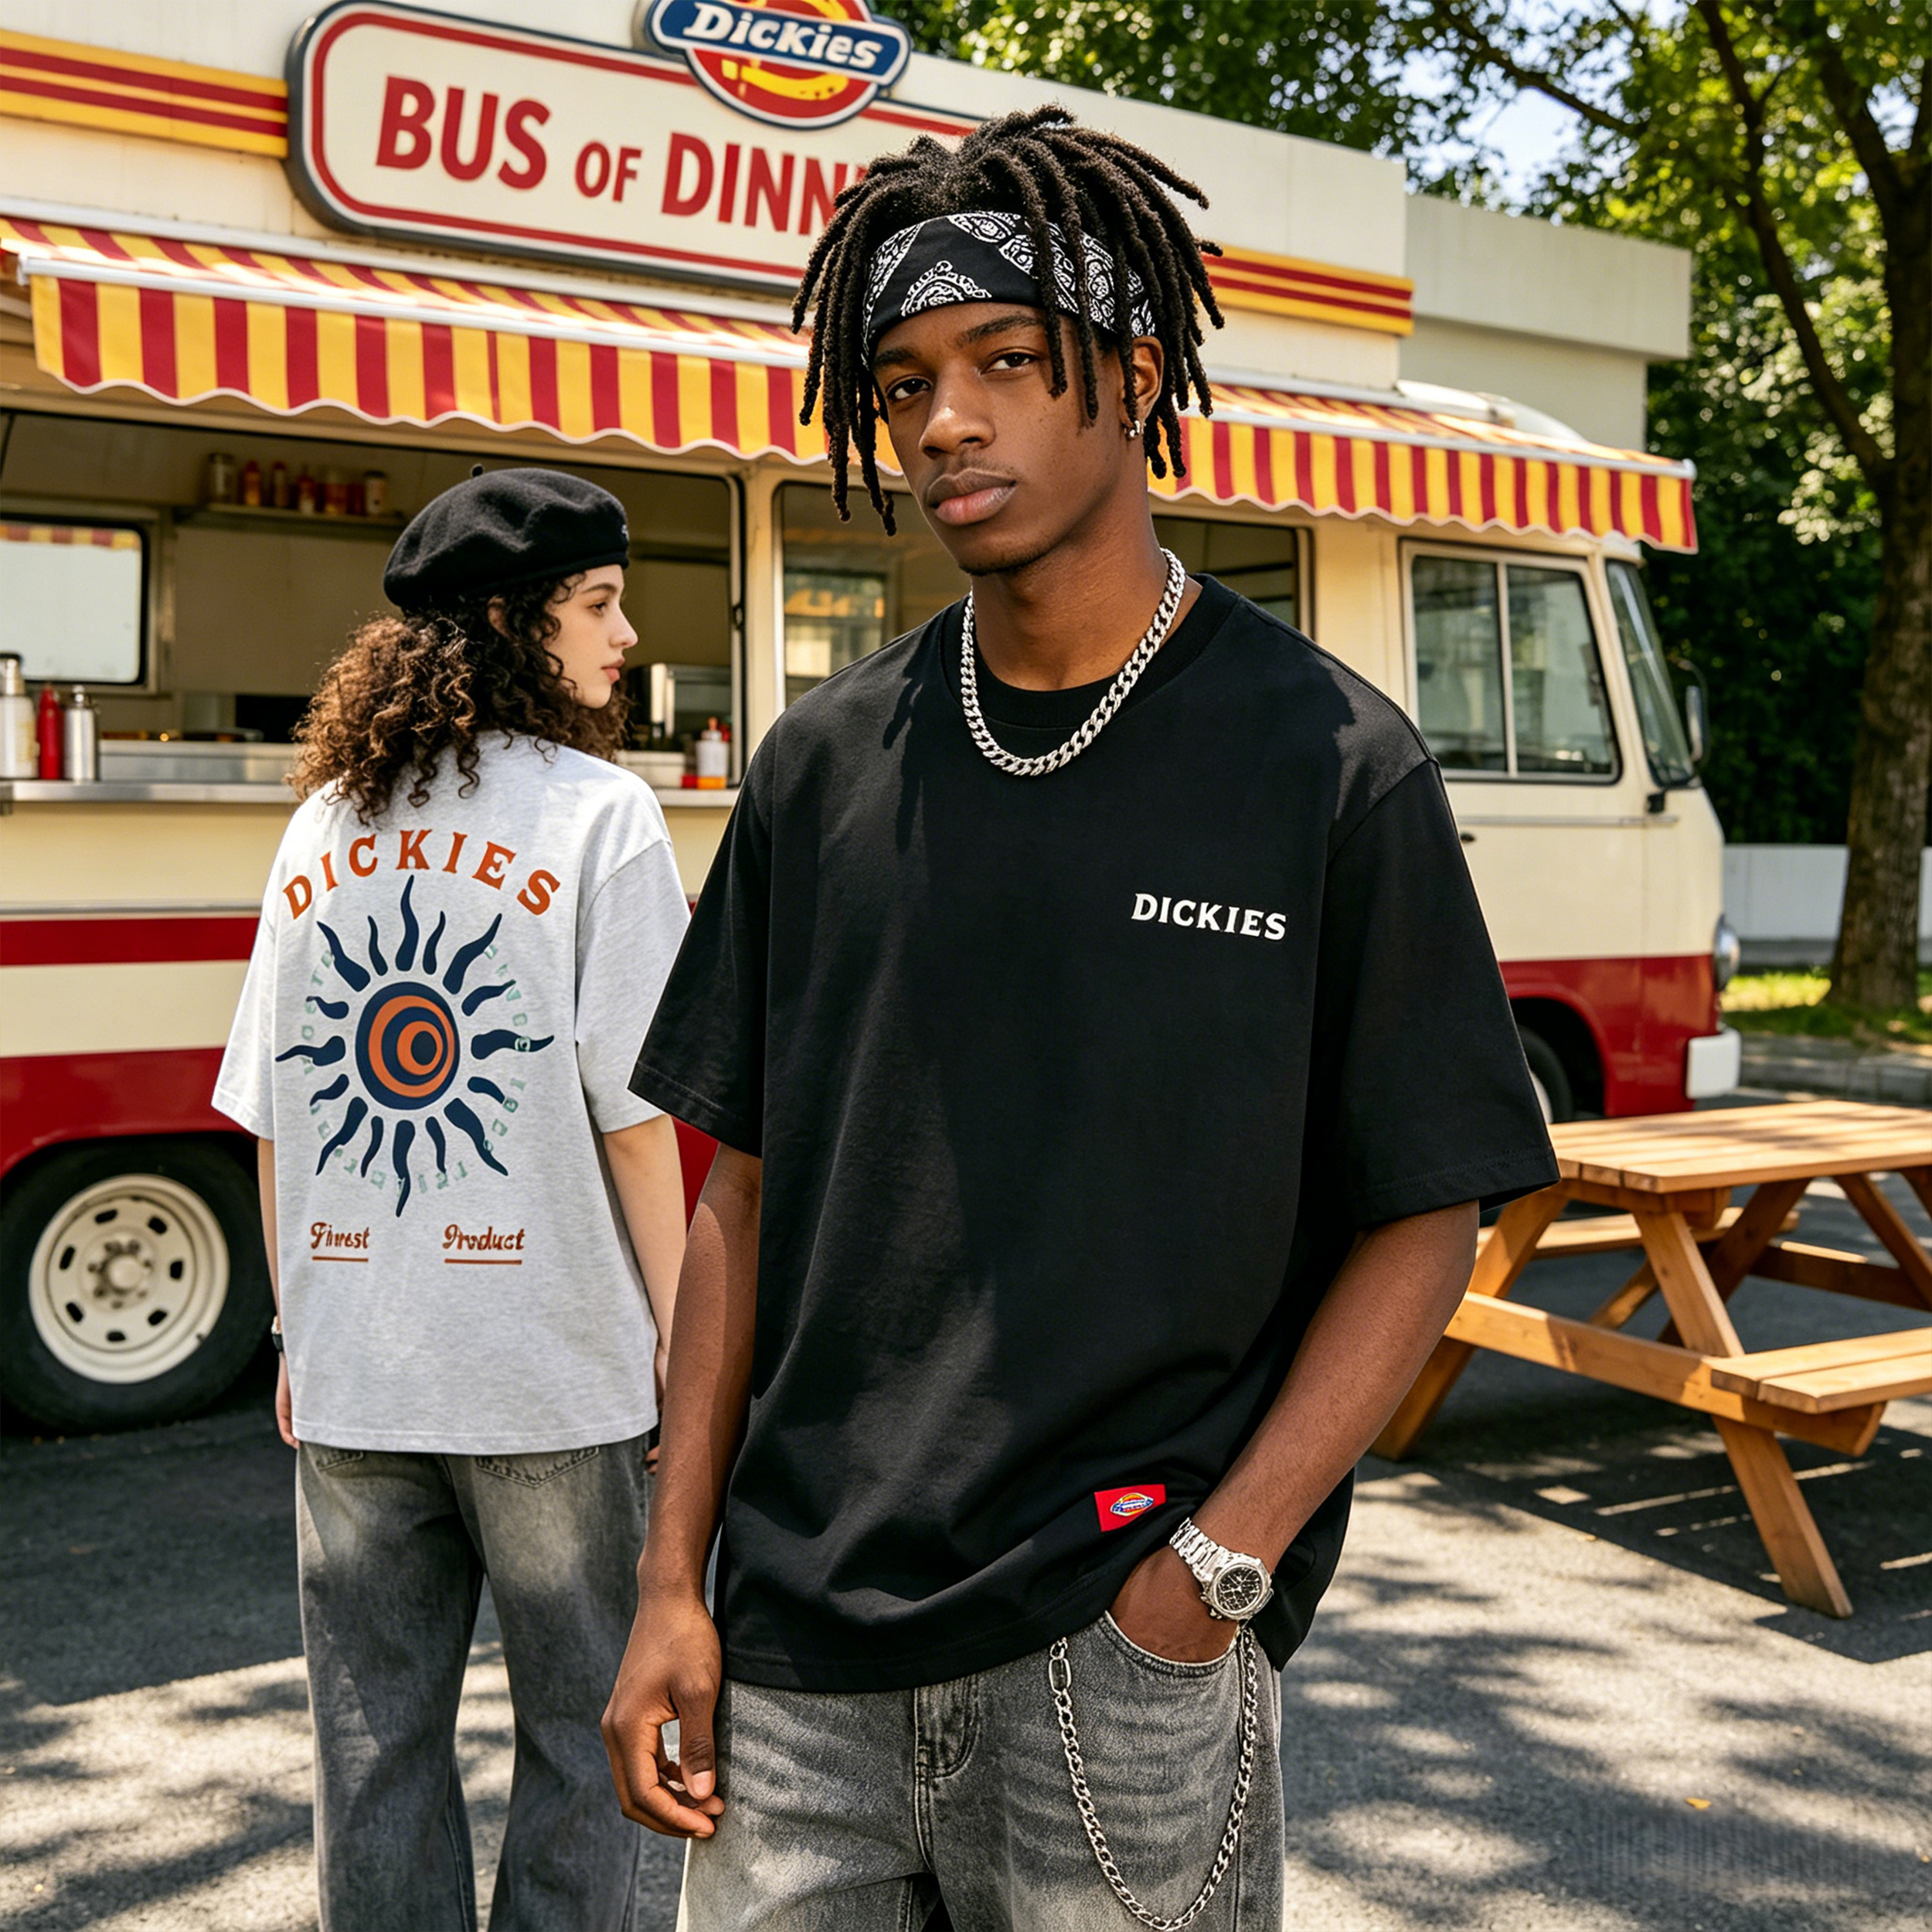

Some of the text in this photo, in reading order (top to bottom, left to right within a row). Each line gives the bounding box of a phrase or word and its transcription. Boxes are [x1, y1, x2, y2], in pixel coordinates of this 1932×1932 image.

[682, 2, 883, 69] Dickies
[376, 76, 867, 236] BUS OF DINN
[283, 828, 561, 920] DICKIES
[1131, 893, 1287, 940] DICKIES
[442, 1223, 526, 1251] Product
